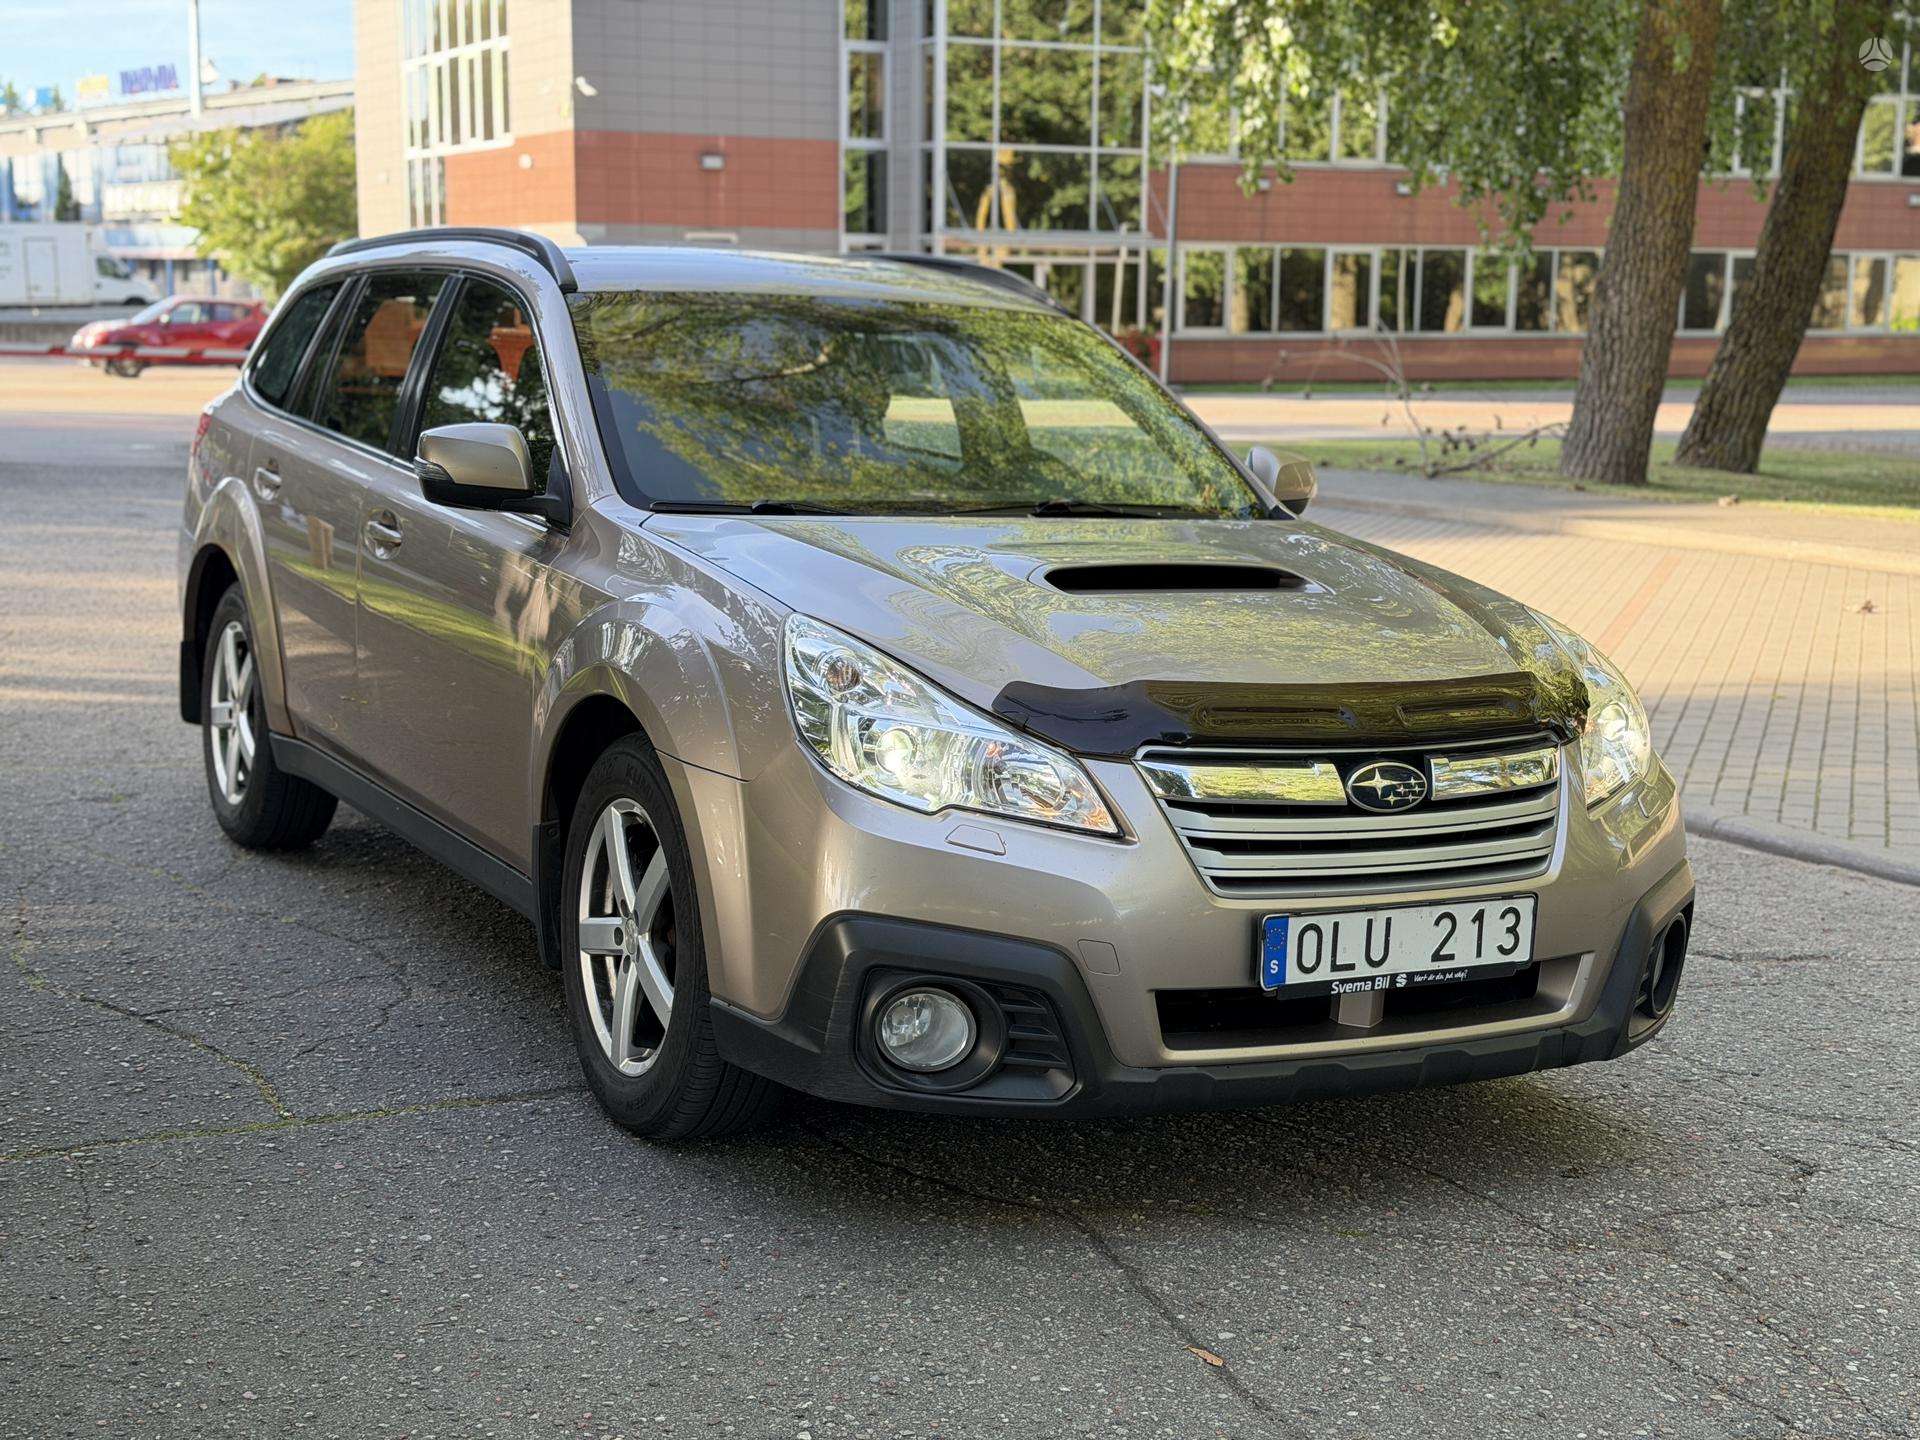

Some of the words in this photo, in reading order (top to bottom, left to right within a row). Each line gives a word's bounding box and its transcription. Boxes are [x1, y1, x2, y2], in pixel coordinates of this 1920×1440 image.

[1296, 916, 1393, 974] OLU
[1430, 906, 1522, 963] 213
[1270, 959, 1279, 975] S
[1331, 980, 1372, 995] Svema
[1374, 975, 1391, 990] Bil
